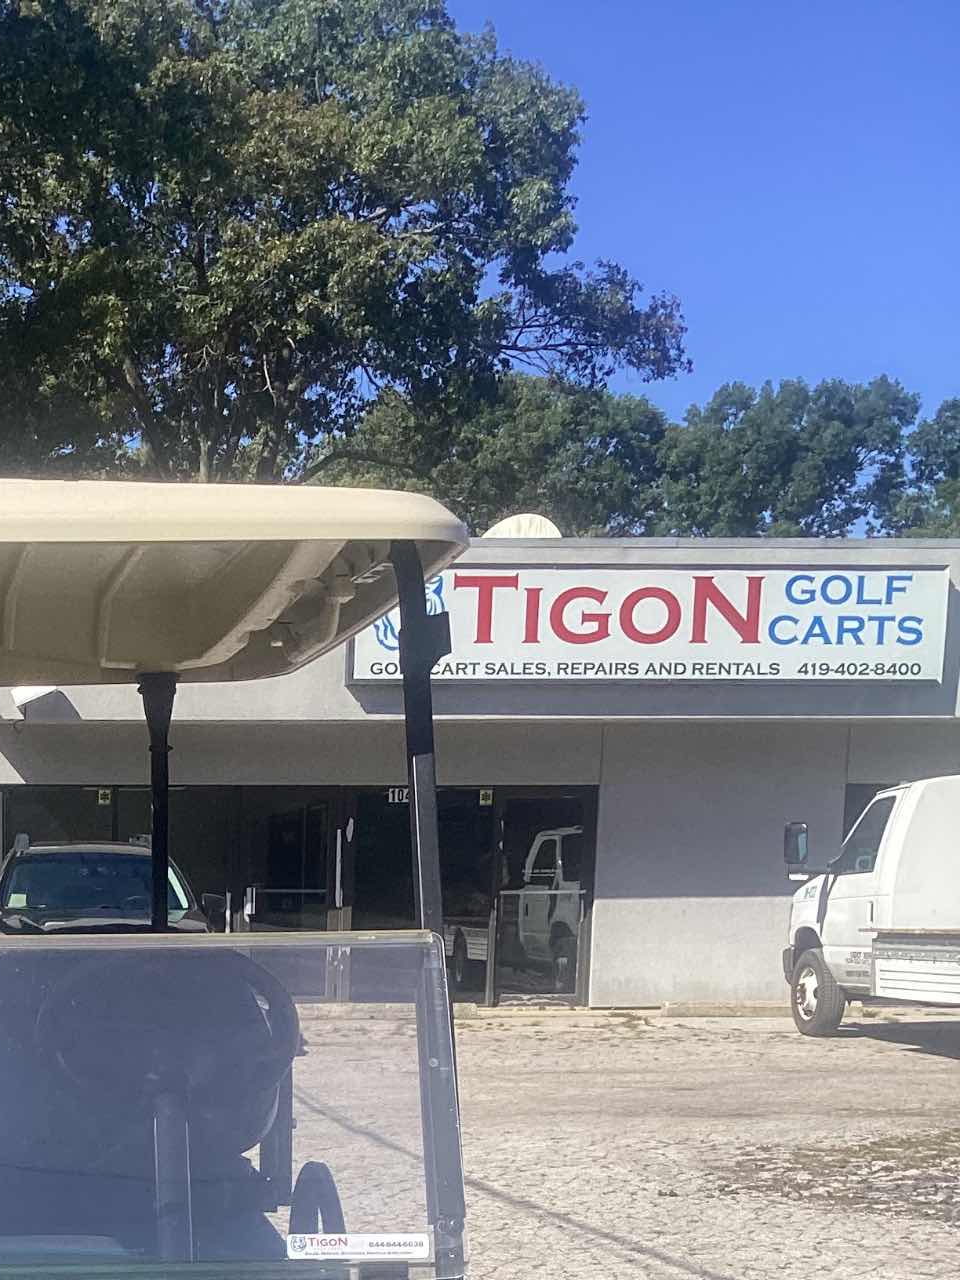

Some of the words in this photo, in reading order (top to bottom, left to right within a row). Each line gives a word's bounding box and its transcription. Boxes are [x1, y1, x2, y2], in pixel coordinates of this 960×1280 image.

[785, 574, 913, 605] GOLF
[454, 575, 765, 644] TIGON
[768, 615, 924, 645] CARTS
[370, 662, 398, 675] GO
[485, 662, 551, 677] SALES,
[557, 662, 639, 675] REPAIRS
[645, 662, 687, 675] AND
[691, 662, 781, 676] RENTALS
[797, 662, 922, 676] 419-402-8400
